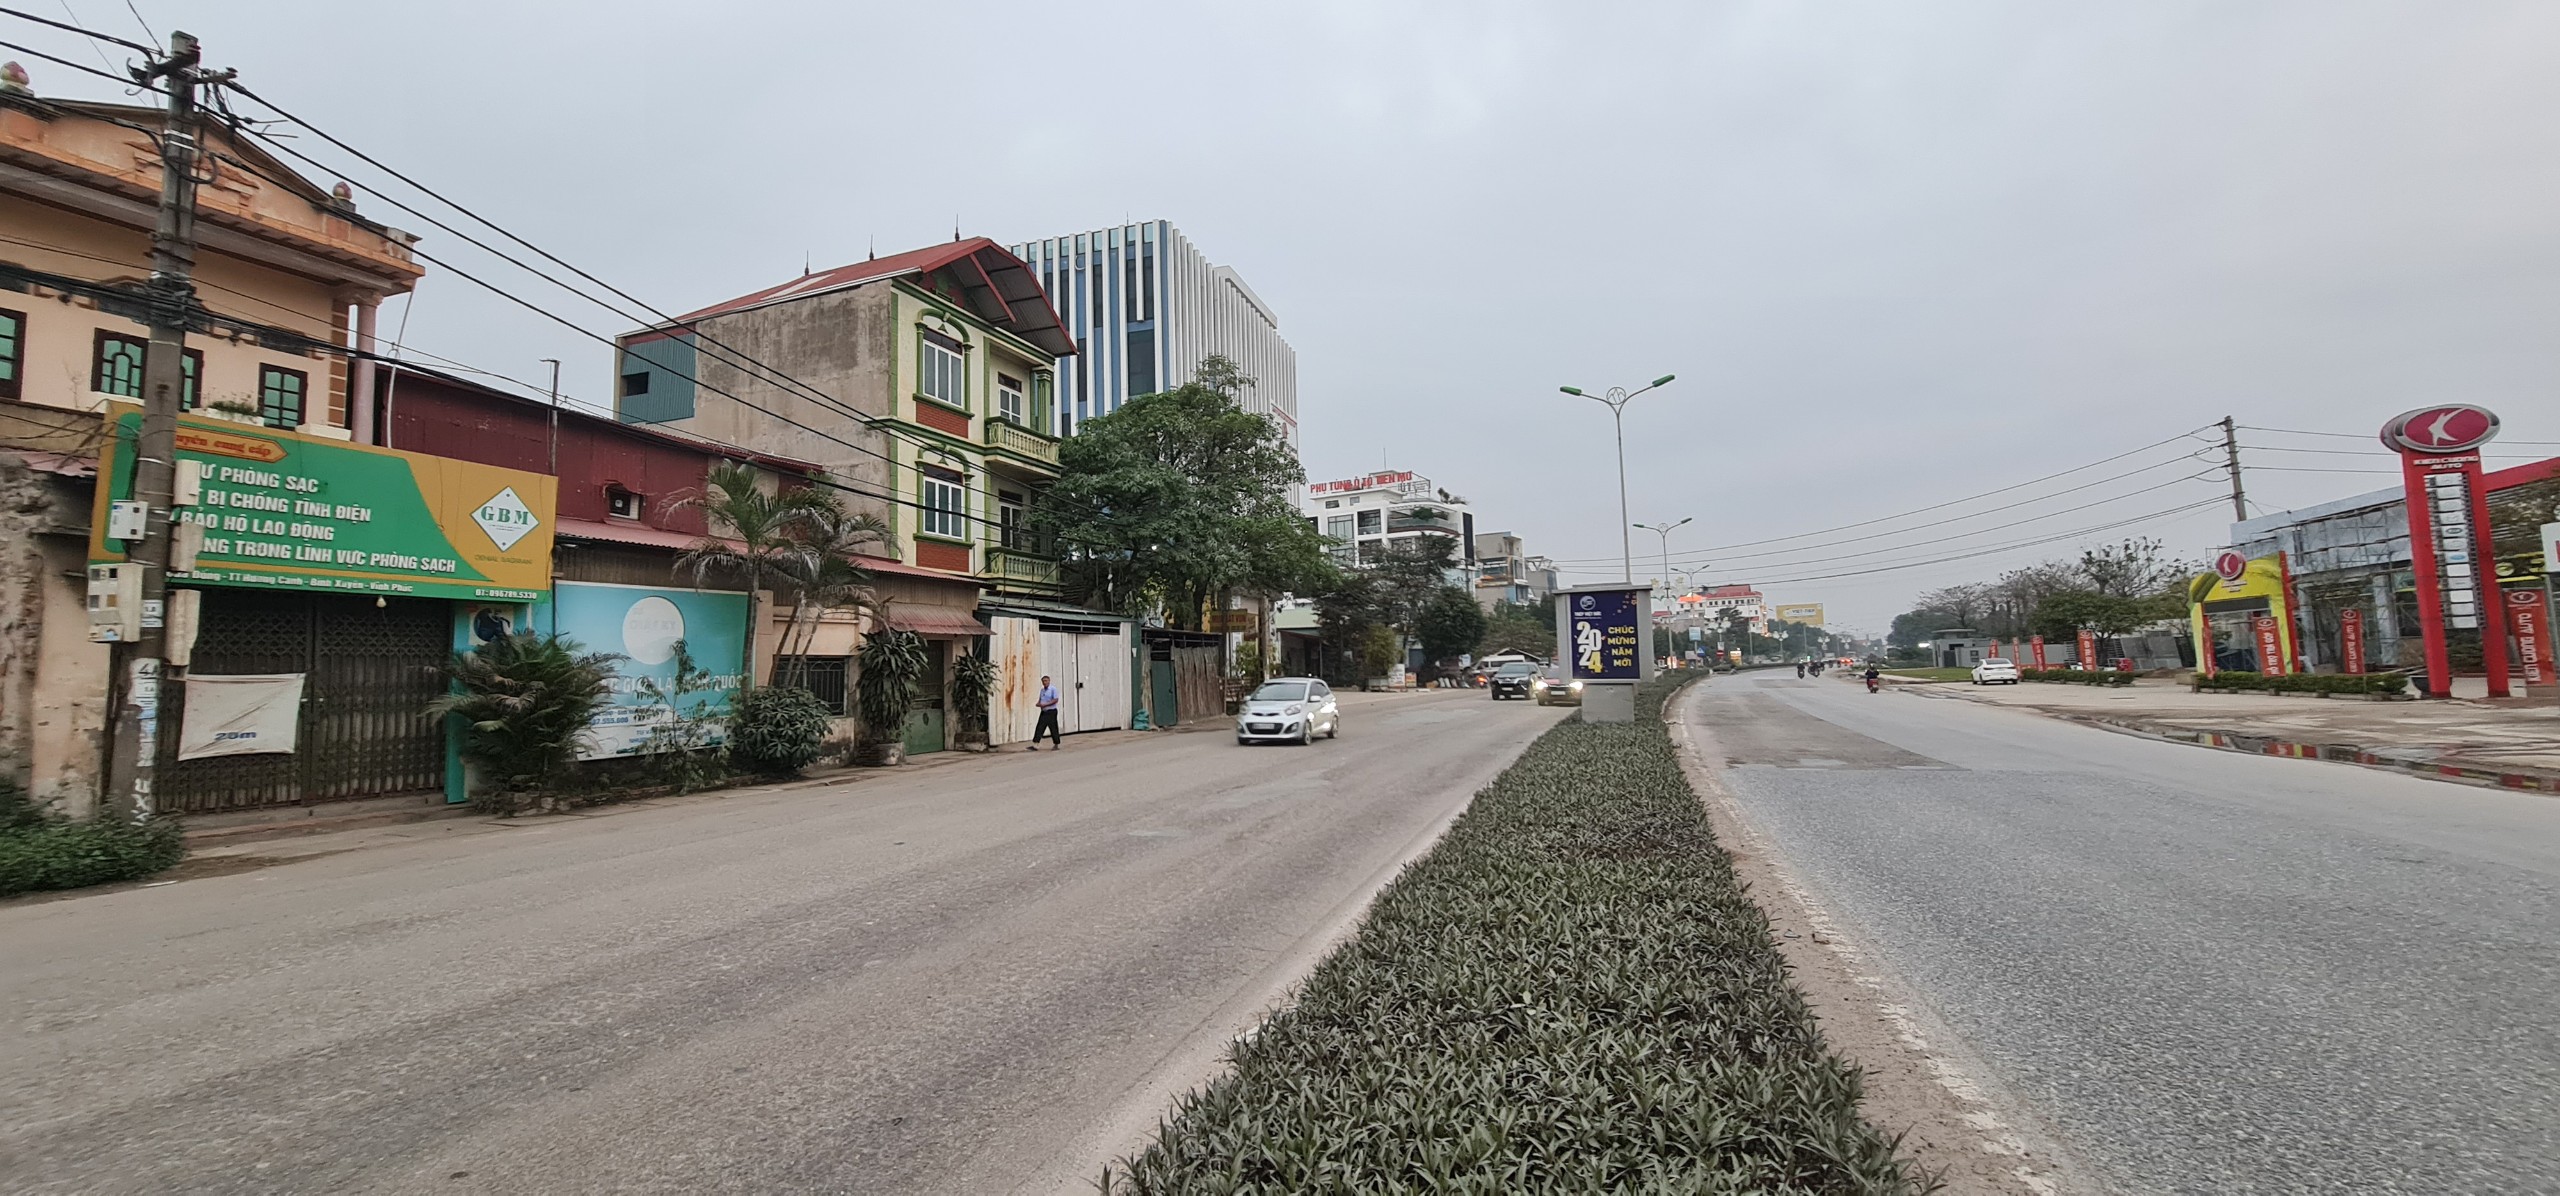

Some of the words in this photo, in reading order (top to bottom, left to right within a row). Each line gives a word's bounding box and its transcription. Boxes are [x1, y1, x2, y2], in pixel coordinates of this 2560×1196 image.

[220, 466, 280, 488] PHÒNG
[285, 475, 319, 494] SẠC
[207, 489, 226, 508] BỊ
[230, 490, 289, 513] CHỐNG
[335, 504, 371, 524] ĐIỆN
[480, 505, 529, 525] GBM
[180, 506, 218, 529] BẢO
[223, 514, 247, 535] HỘ
[252, 518, 285, 536] LAO
[290, 520, 335, 541] ĐỘNG
[235, 540, 291, 560] TRONG
[295, 543, 332, 563] LĨNH
[336, 550, 367, 568] VỰC
[370, 551, 417, 570] PHÒNG
[420, 558, 456, 574] SẠCH
[1608, 625, 1635, 634] CHÚC
[1607, 635, 1636, 645] MỪNG
[1611, 646, 1633, 656] NĂM
[1613, 657, 1632, 667] MỚI
